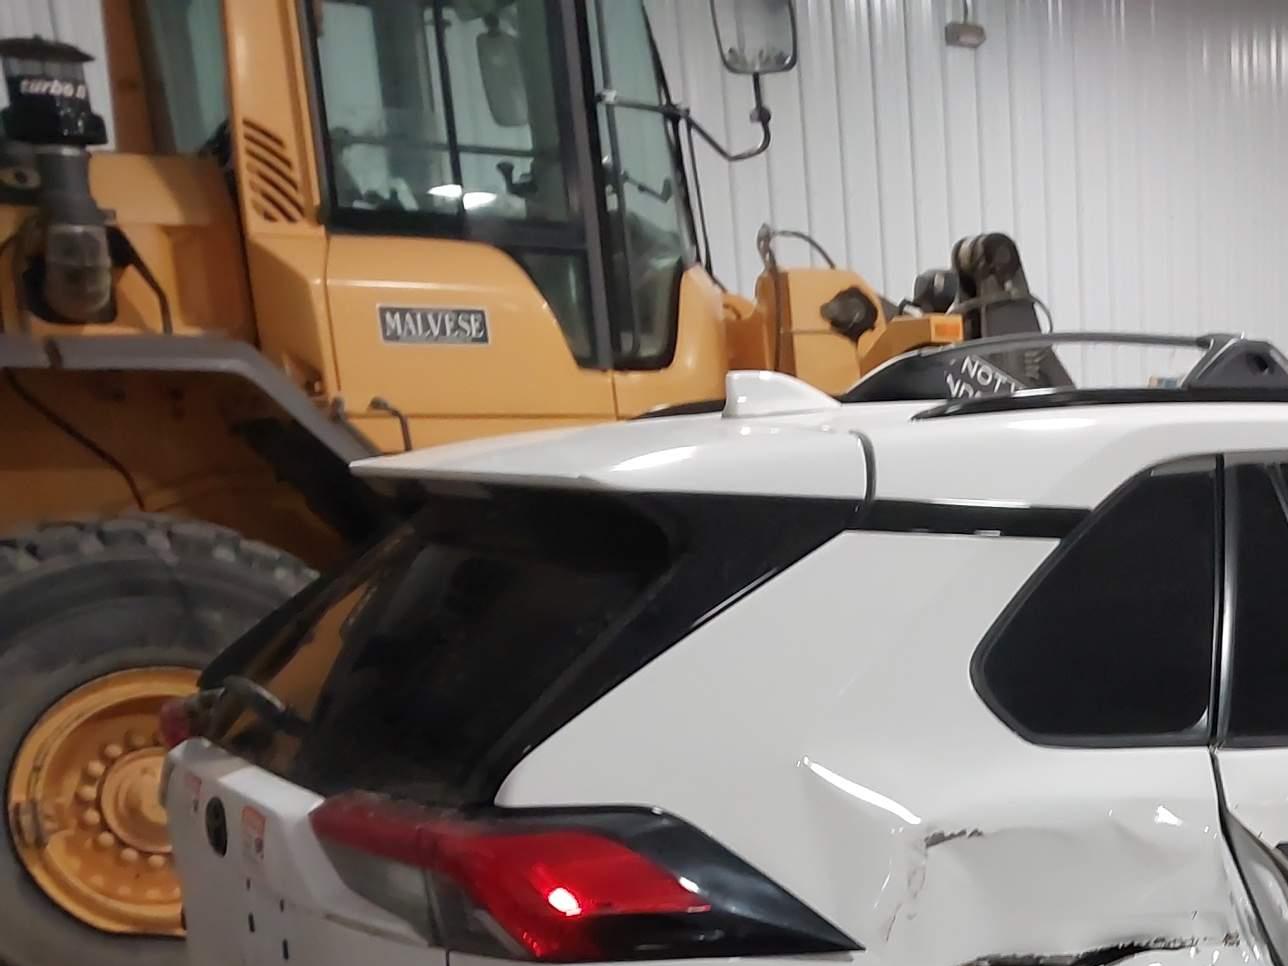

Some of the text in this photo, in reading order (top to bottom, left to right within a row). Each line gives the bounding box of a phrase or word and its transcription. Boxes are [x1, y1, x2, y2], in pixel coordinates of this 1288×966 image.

[20, 79, 74, 97] turbo
[385, 311, 484, 337] MALVESE
[961, 355, 1004, 393] NOT
